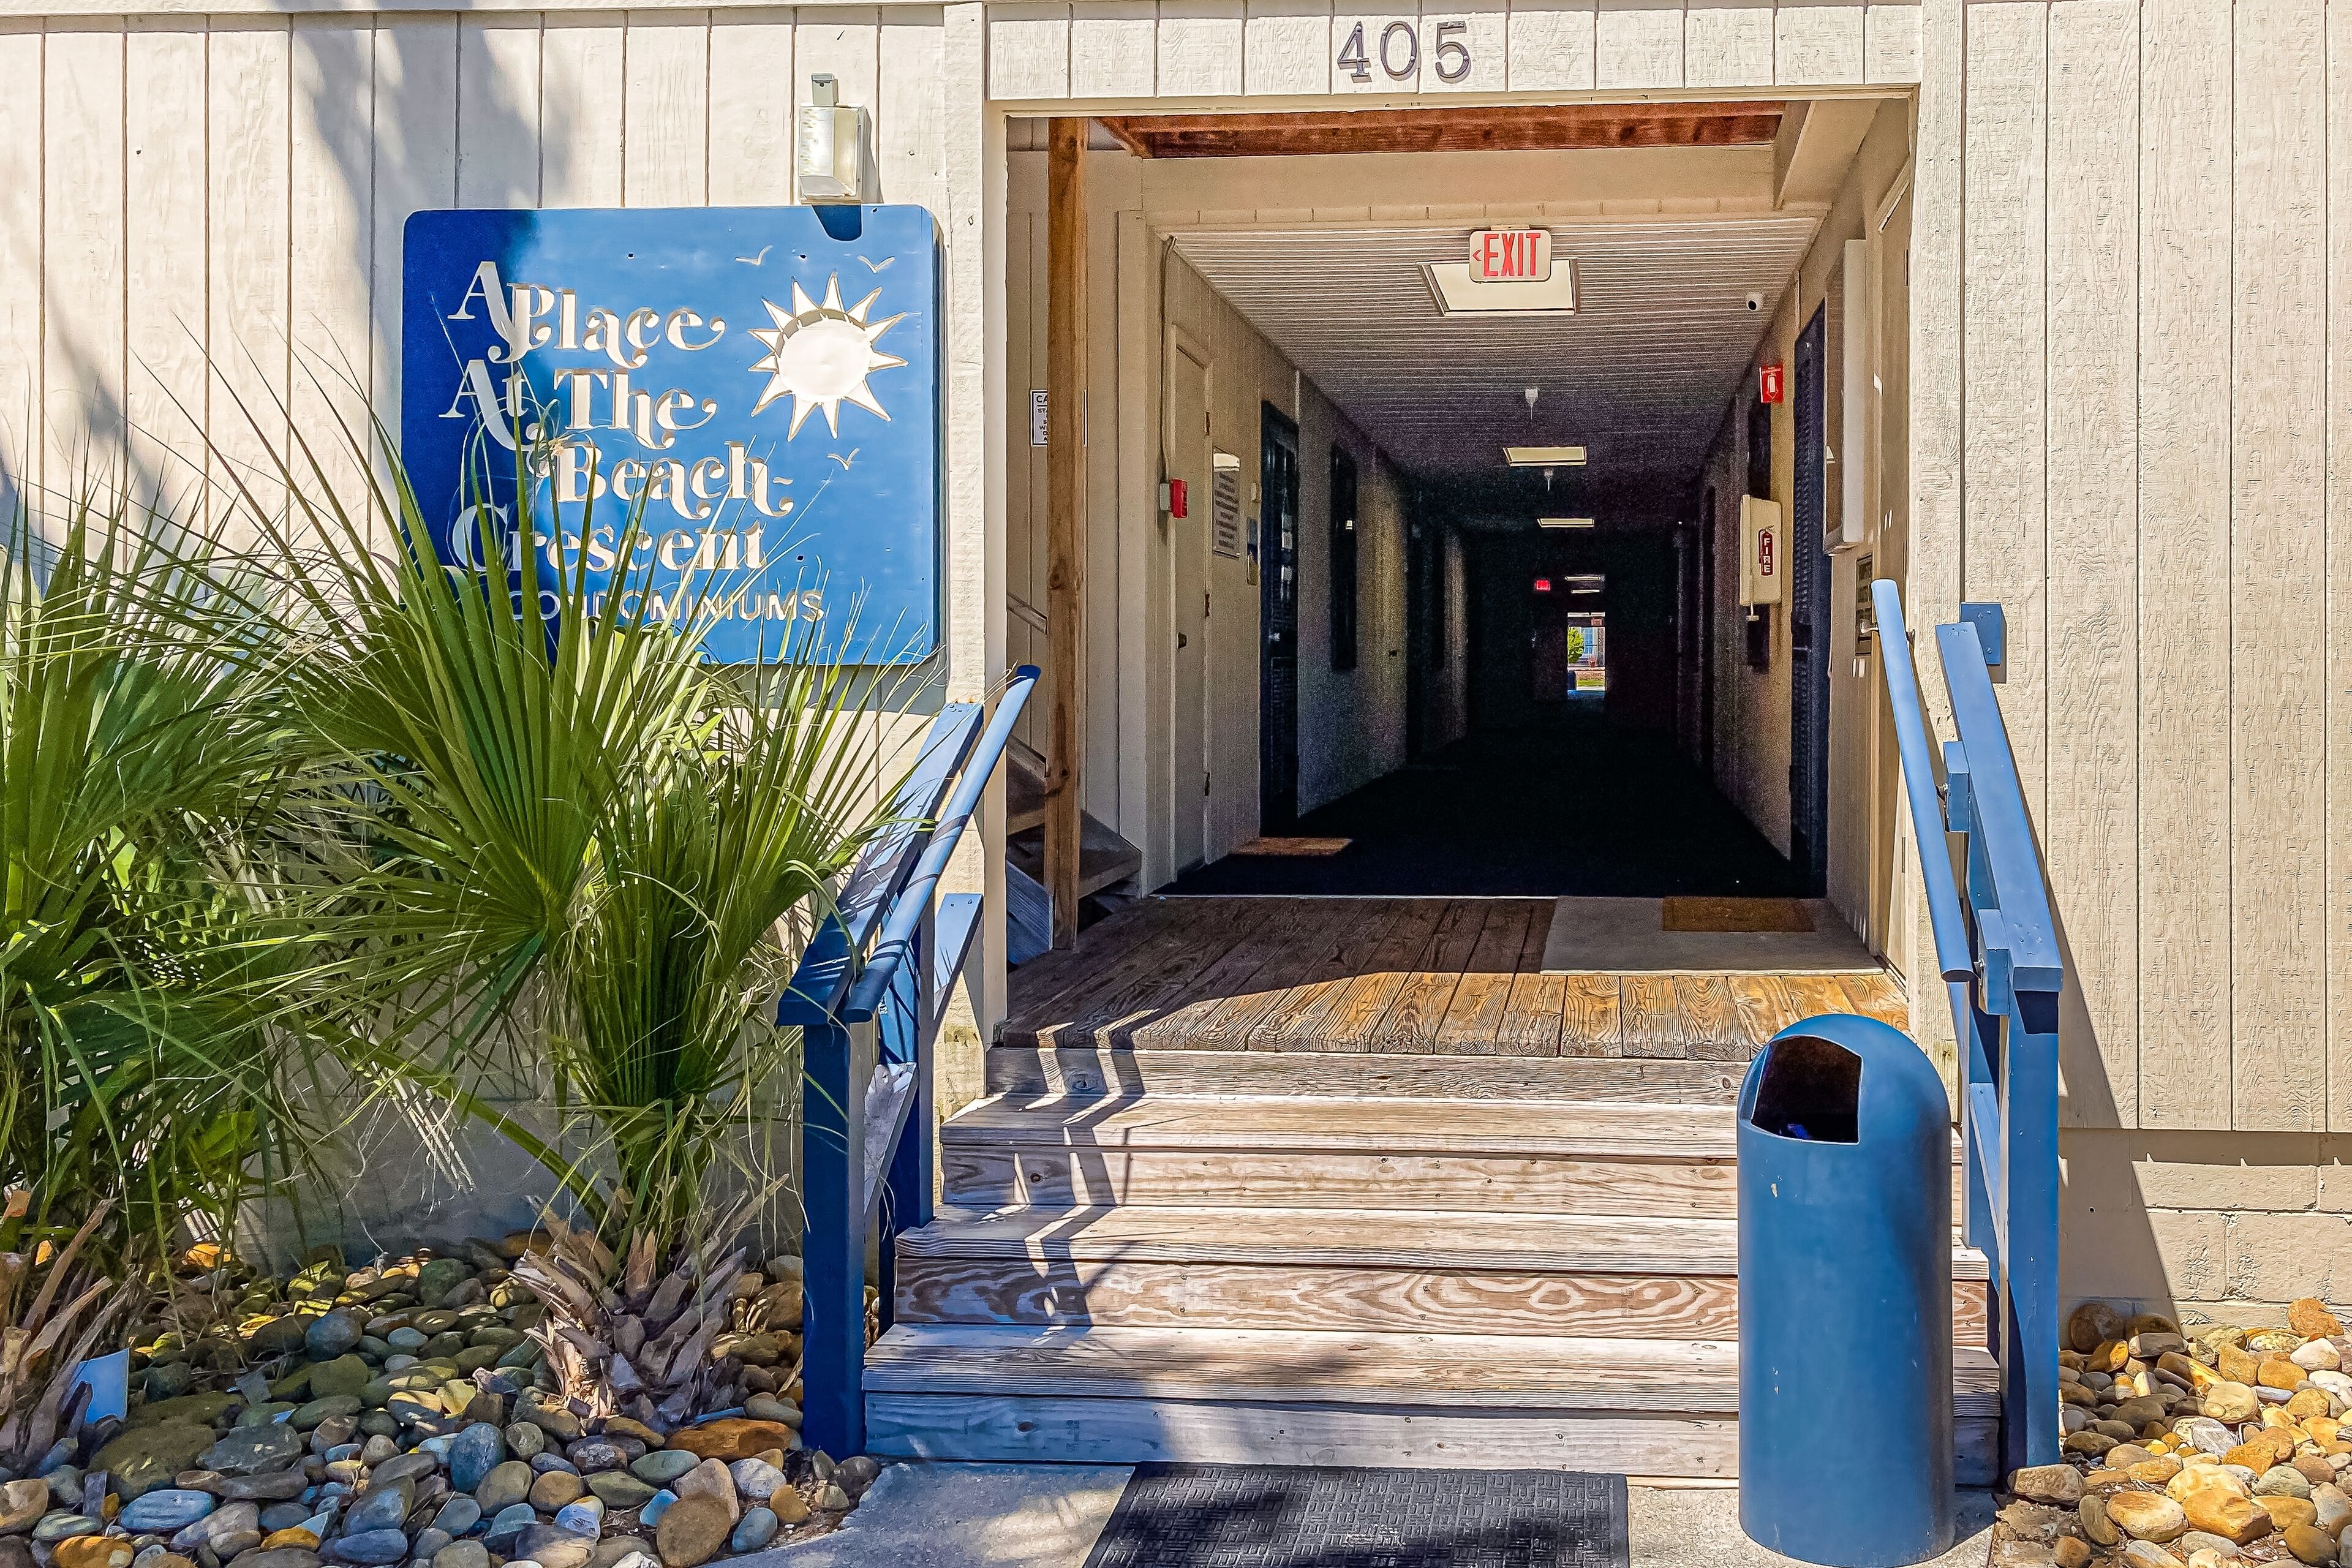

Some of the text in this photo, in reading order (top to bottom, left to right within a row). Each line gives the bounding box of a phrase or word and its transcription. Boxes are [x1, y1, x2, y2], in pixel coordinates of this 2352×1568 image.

[1338, 21, 1470, 81] 405
[1483, 233, 1541, 276] EXIT
[448, 262, 726, 369] A Place
[439, 360, 718, 451] At The
[452, 503, 767, 572] Crescent
